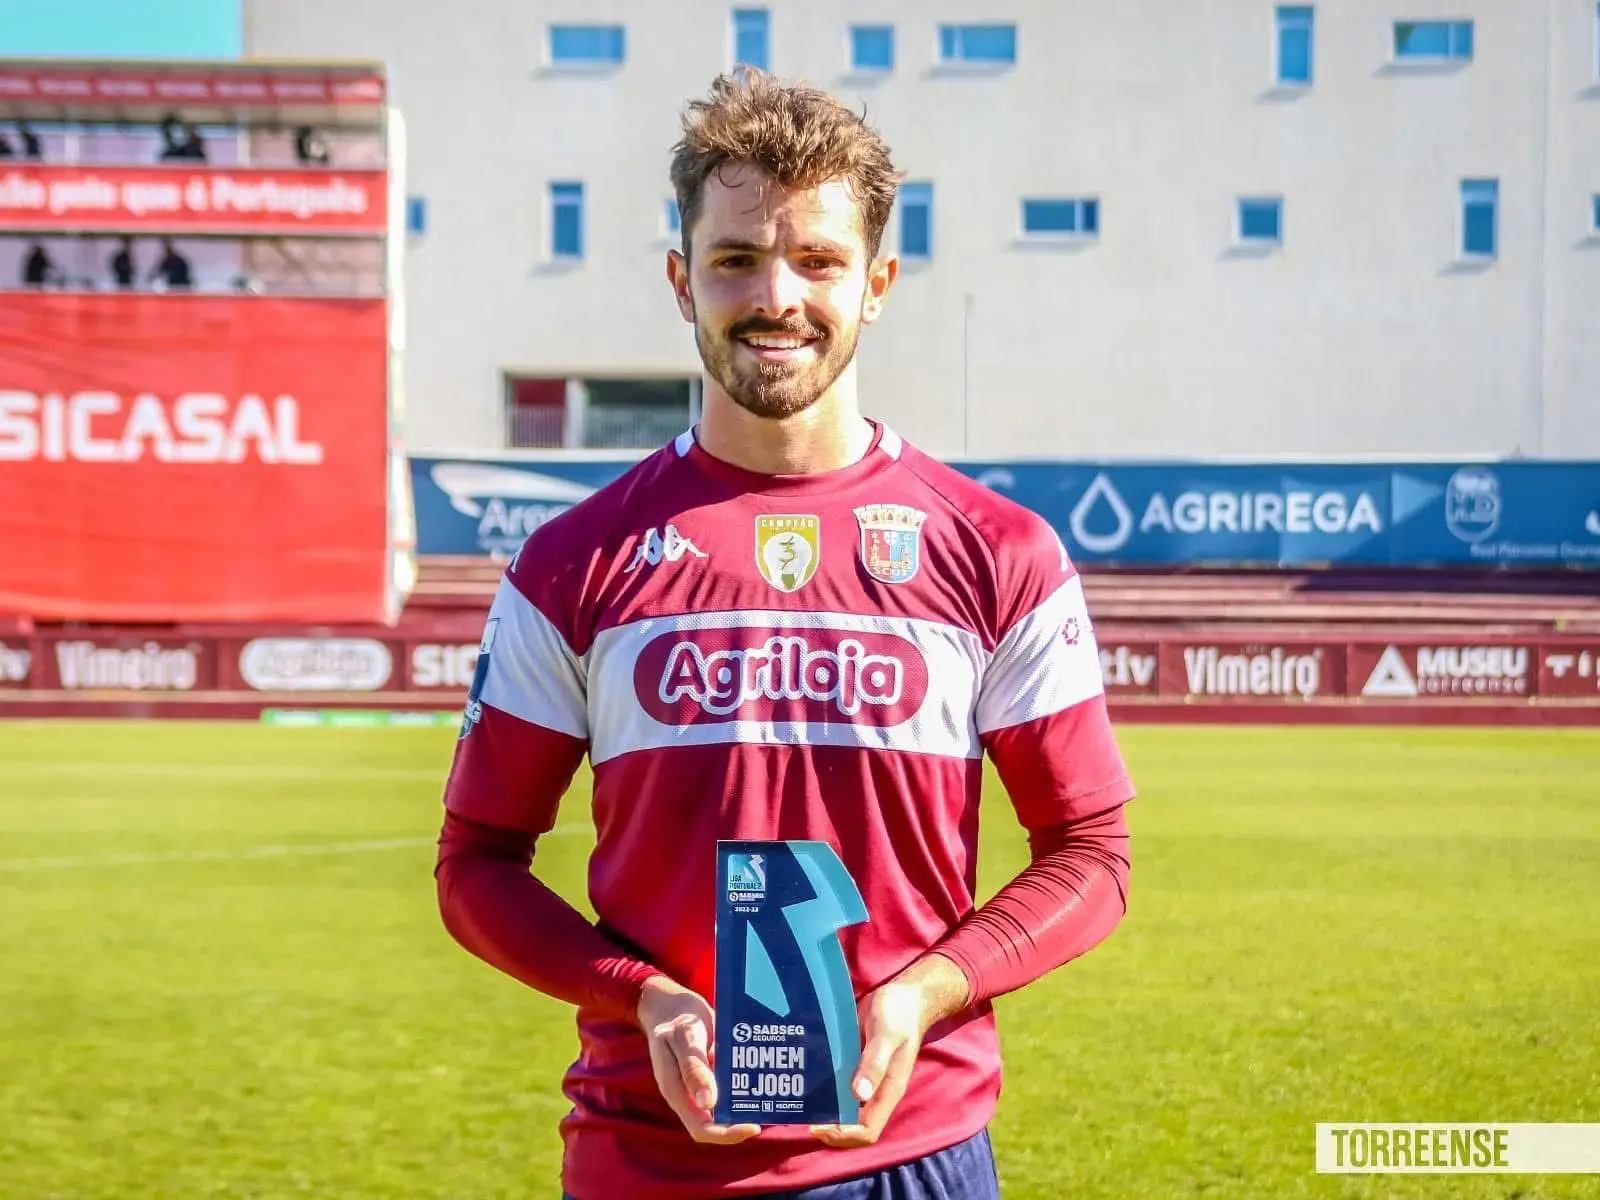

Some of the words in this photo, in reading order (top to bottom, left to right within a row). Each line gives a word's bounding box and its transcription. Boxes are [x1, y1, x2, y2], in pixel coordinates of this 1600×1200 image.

[0, 390, 324, 464] SICASAL
[1139, 491, 1383, 534] AGRIREGA
[659, 636, 904, 716] Agriloja
[1183, 646, 1319, 695] Vimeiro
[1416, 647, 1527, 677] MUSEU
[752, 1024, 805, 1036] SABSEG
[752, 1034, 786, 1042] SEGUROS
[732, 1045, 805, 1069] HOMEM
[731, 1072, 750, 1090] DO
[751, 1072, 805, 1097] JOGO
